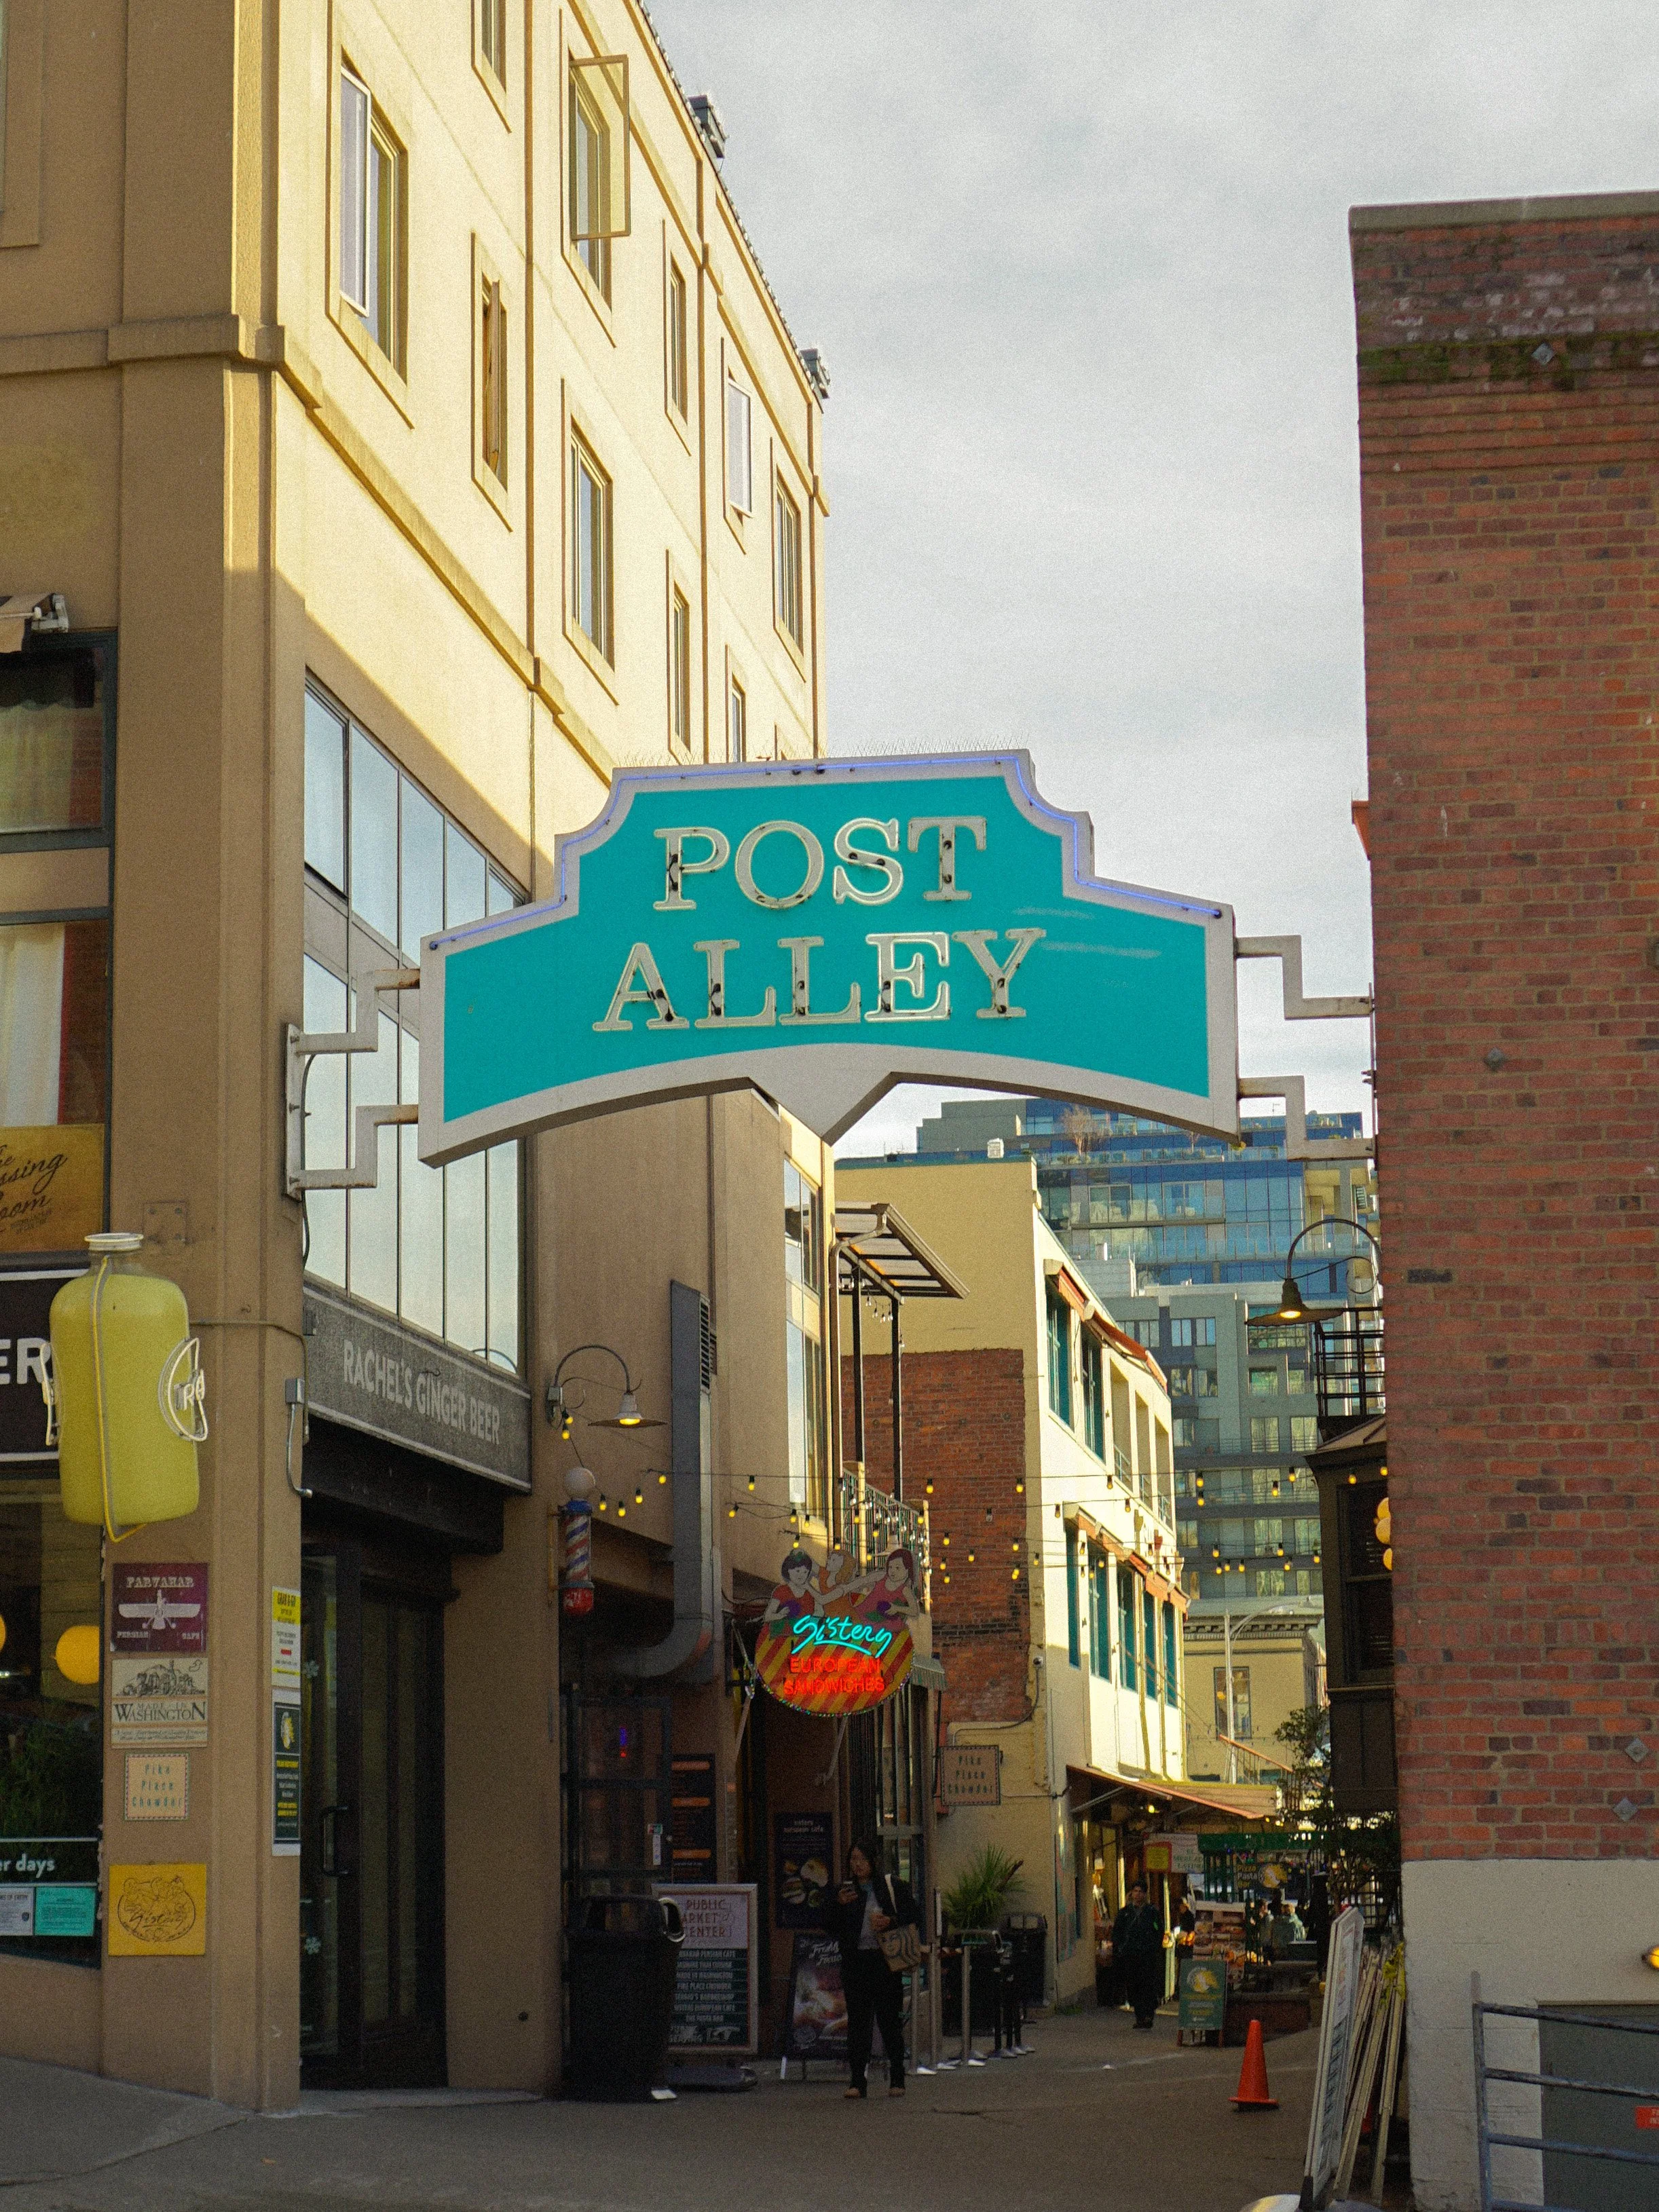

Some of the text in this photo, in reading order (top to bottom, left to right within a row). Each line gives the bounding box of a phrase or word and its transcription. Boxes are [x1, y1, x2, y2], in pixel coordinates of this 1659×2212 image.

[653, 817, 987, 911] POST
[592, 927, 1047, 1032] ALLEY
[343, 1339, 500, 1445] RACHEL'S GINGER BEER
[790, 1656, 880, 1673] EUROPEAN
[783, 1676, 884, 1695] SANDWICHES
[113, 1702, 206, 1722] WASHINGTON
[145, 1765, 170, 1776] Pike
[141, 1780, 174, 1792] Place
[132, 1796, 184, 1808] Chowder
[15, 1853, 56, 1879] days
[686, 1899, 726, 1910] PUBLIC
[682, 1913, 718, 1924] ARKET
